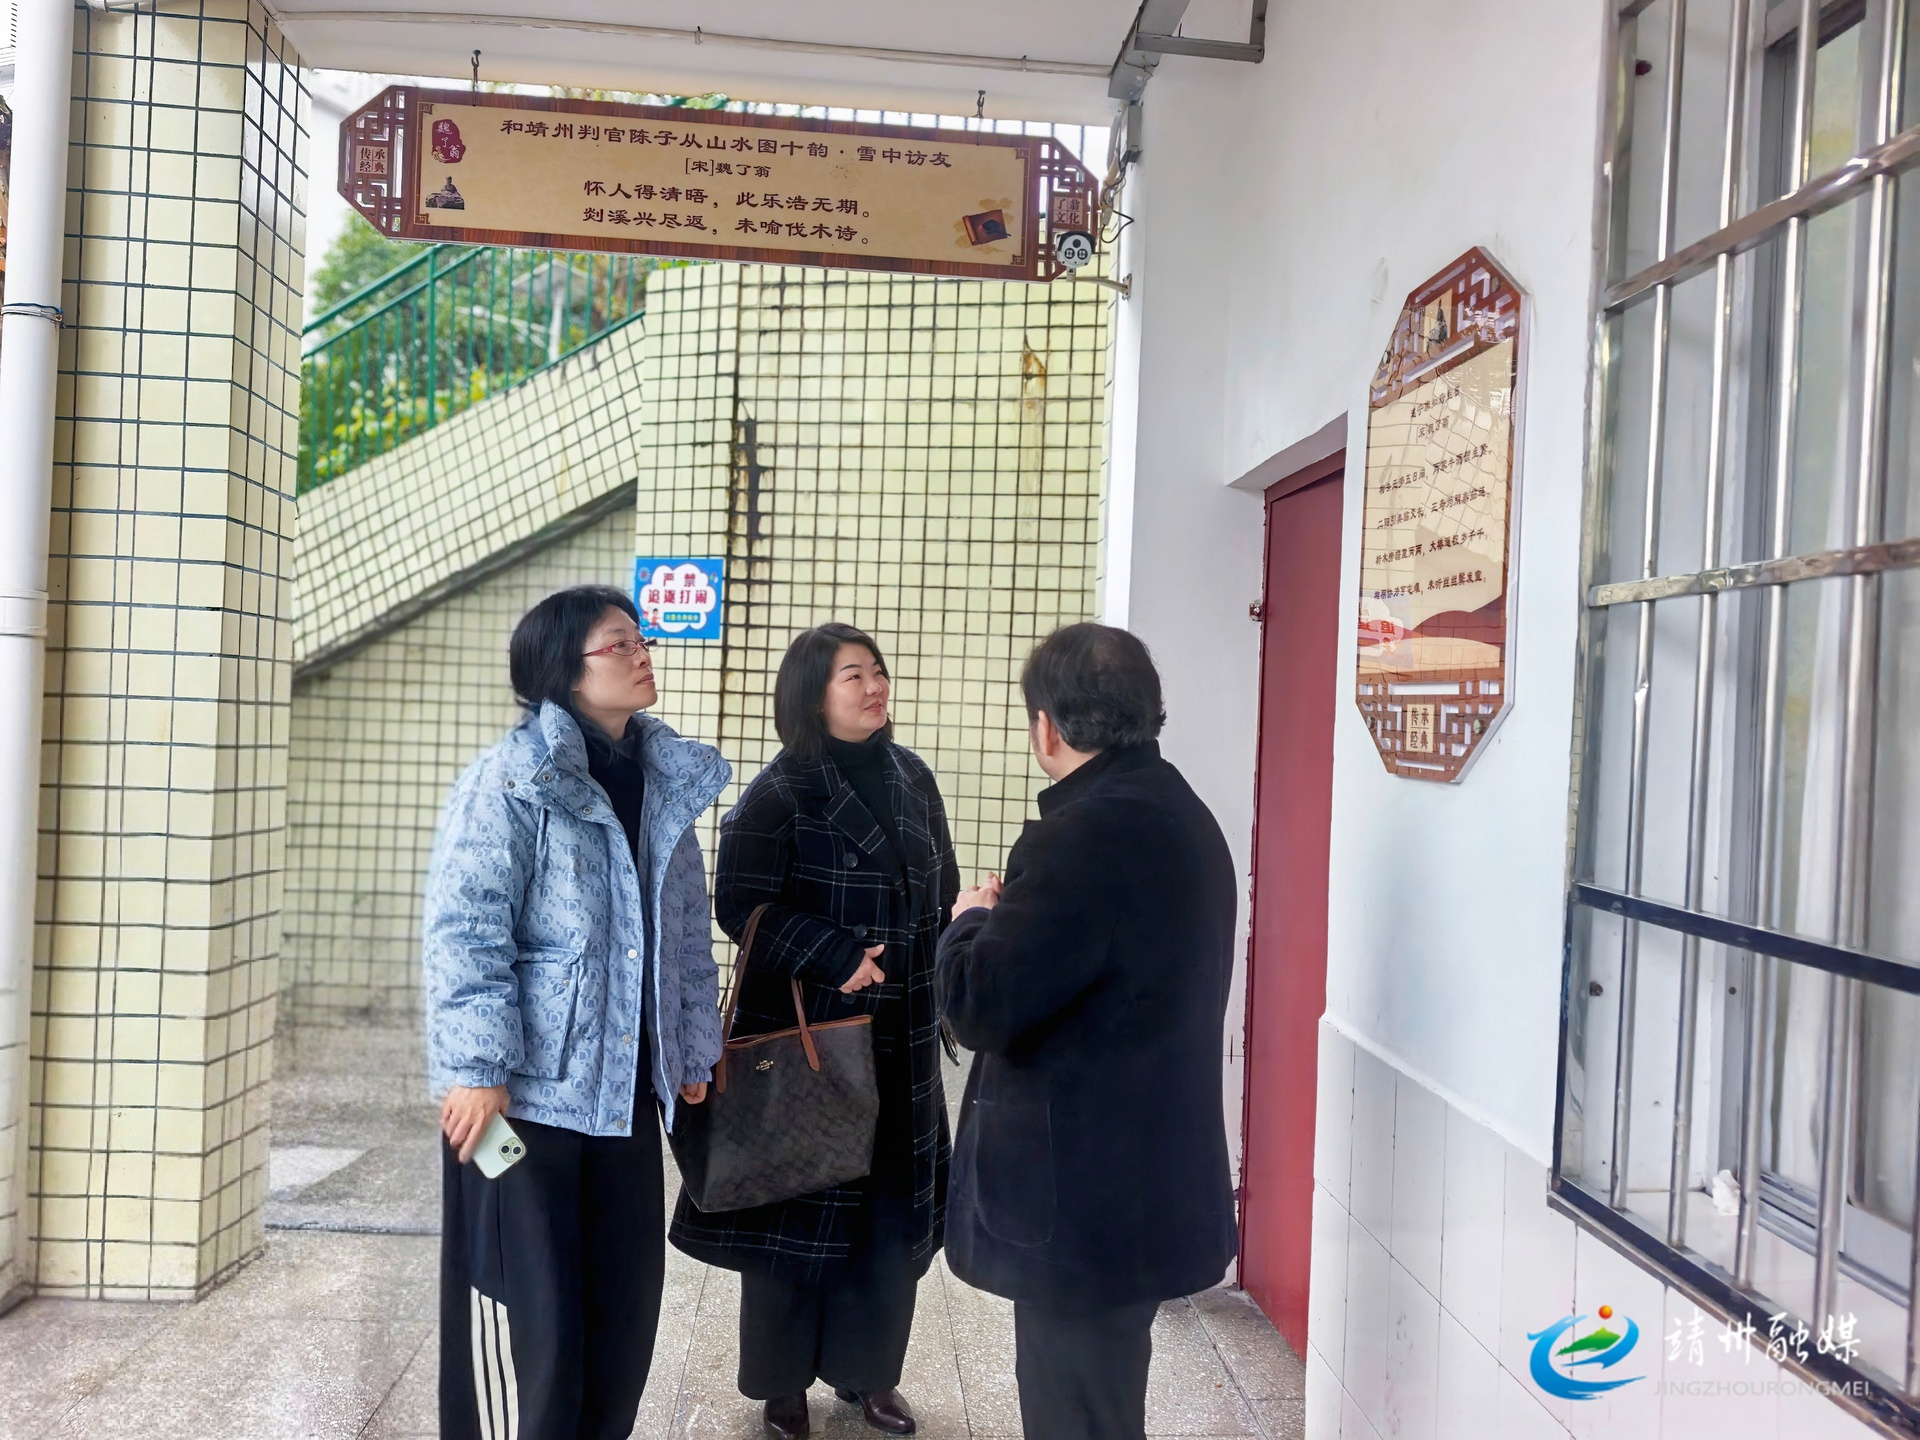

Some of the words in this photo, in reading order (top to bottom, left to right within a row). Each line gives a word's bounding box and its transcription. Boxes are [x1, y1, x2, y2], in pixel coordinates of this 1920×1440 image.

[436, 121, 460, 159] 魏了翁
[500, 119, 953, 169] 和靖州判官陈子从山水图十韵·雪中访友
[360, 147, 386, 160] 传承
[359, 161, 386, 173] 经典
[685, 157, 772, 179] [宋]魏了翁
[1057, 198, 1081, 211] 了翁
[1056, 212, 1080, 224] 文化
[662, 572, 696, 588] 严禁
[648, 589, 708, 605] 追逐打闹
[1411, 707, 1430, 726] 传承
[1410, 730, 1429, 750] 经典
